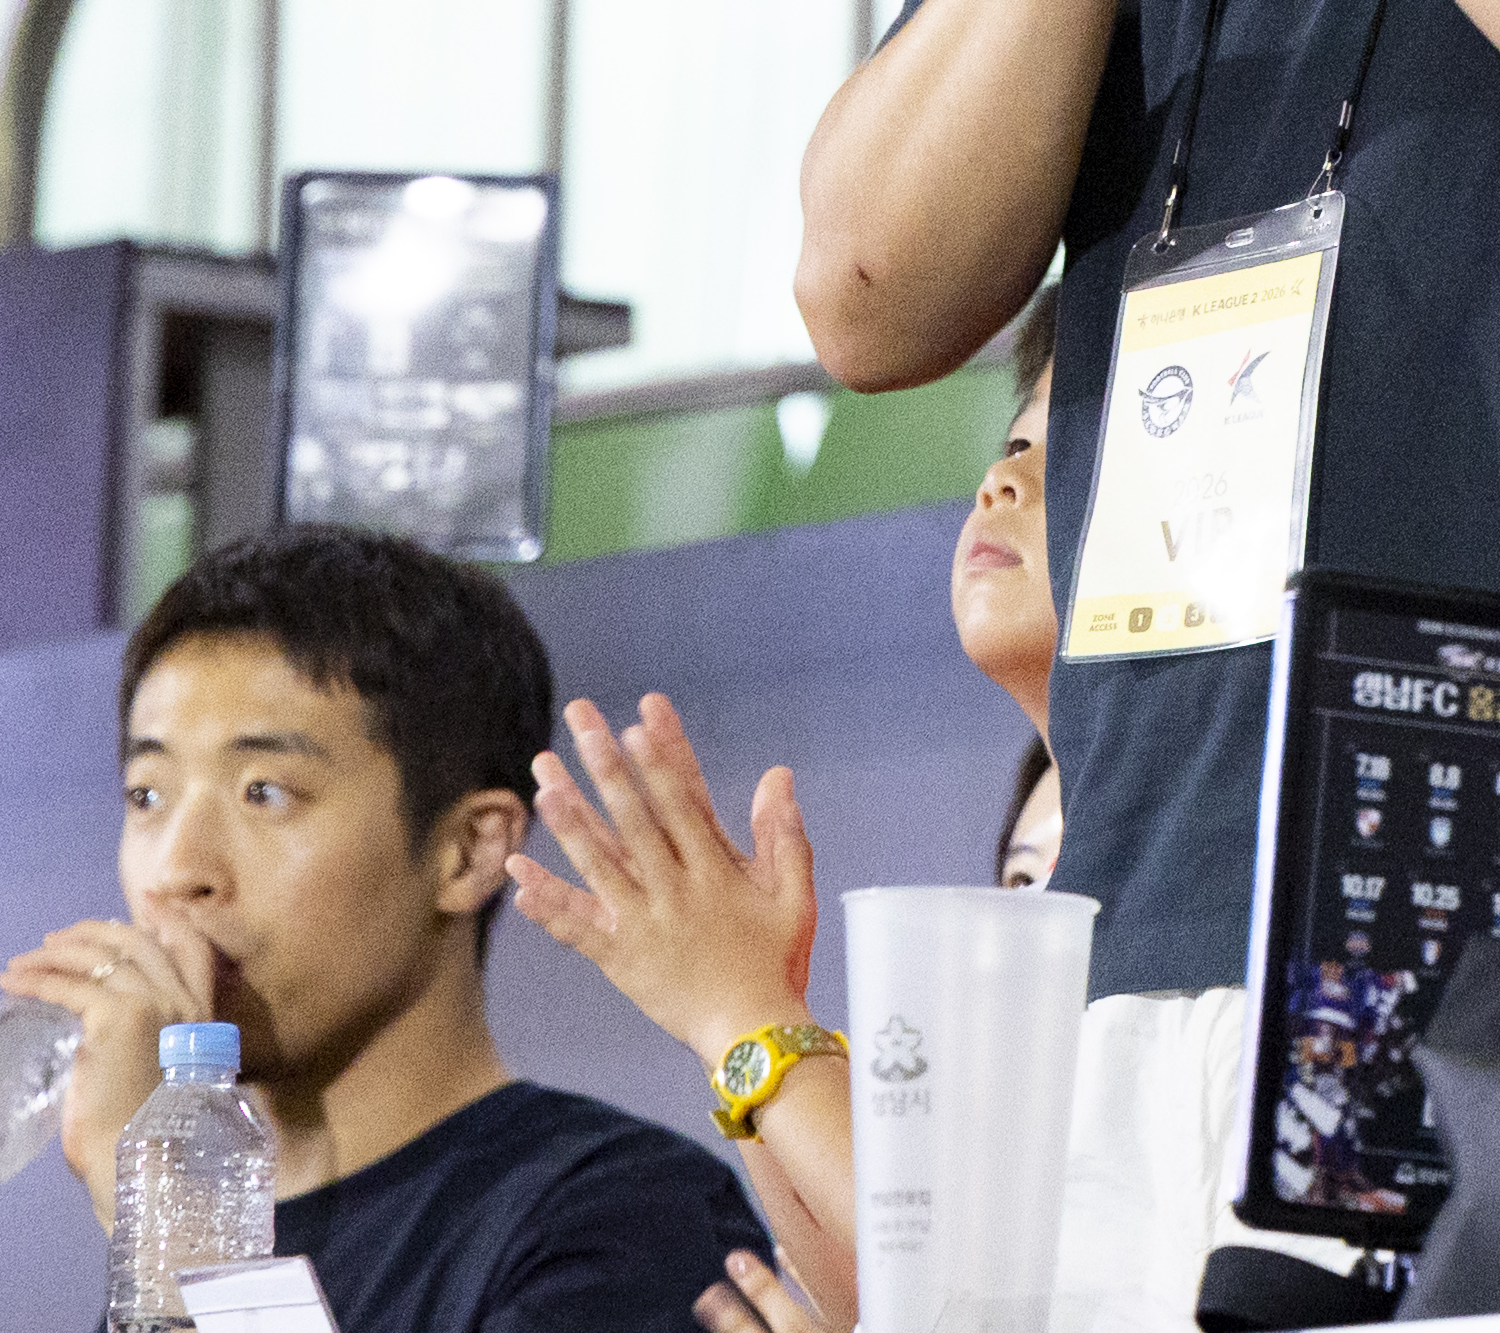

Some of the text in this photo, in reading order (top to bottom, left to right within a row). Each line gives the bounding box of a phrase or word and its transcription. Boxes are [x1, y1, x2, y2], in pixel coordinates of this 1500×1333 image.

[1203, 293, 1249, 314] LEAGUE
[1250, 292, 1258, 304] 2
[1260, 285, 1286, 302] 2026
[1161, 506, 1233, 562] VIP
